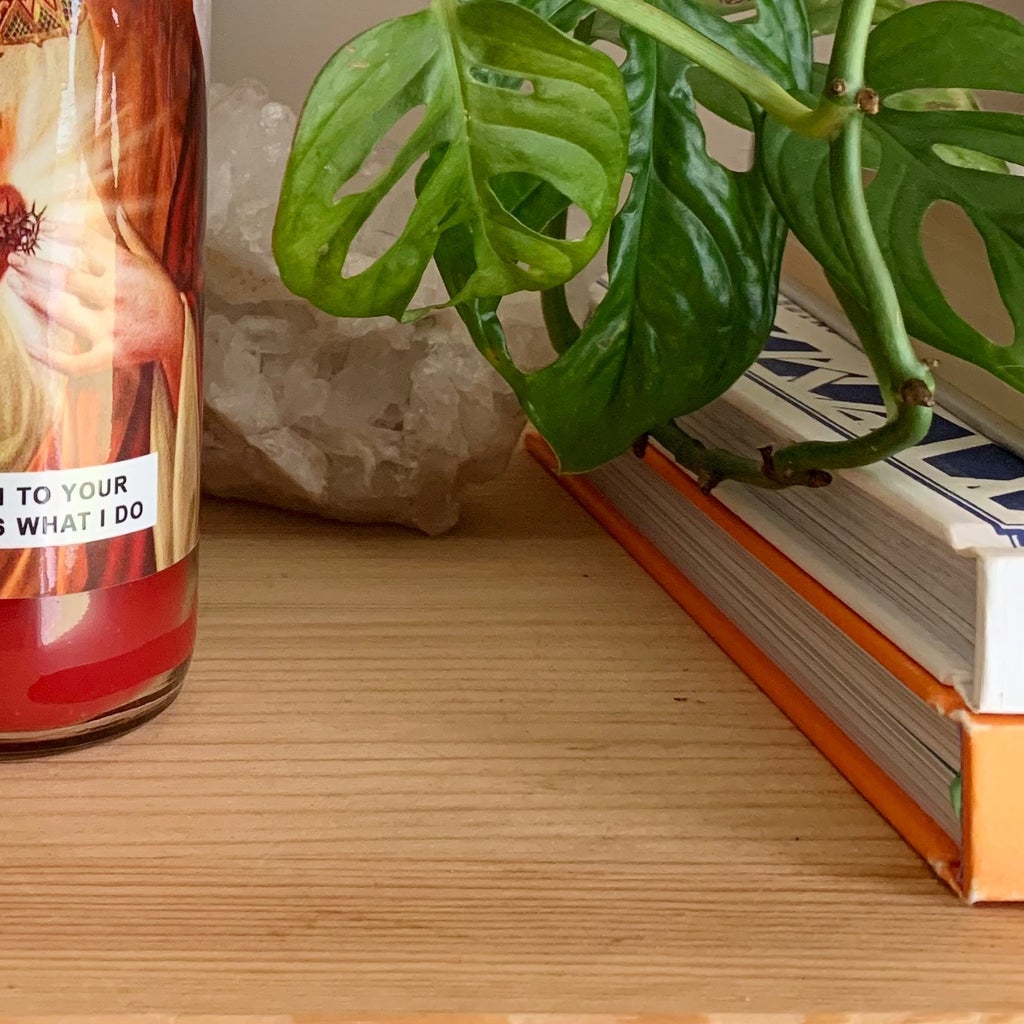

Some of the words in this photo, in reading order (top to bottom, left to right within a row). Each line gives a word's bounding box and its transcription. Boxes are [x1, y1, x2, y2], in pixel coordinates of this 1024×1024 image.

[16, 485, 52, 506] TO
[60, 475, 128, 501] YOUR
[16, 511, 91, 536] WHAT
[99, 508, 107, 527] I
[114, 500, 144, 525] DO
